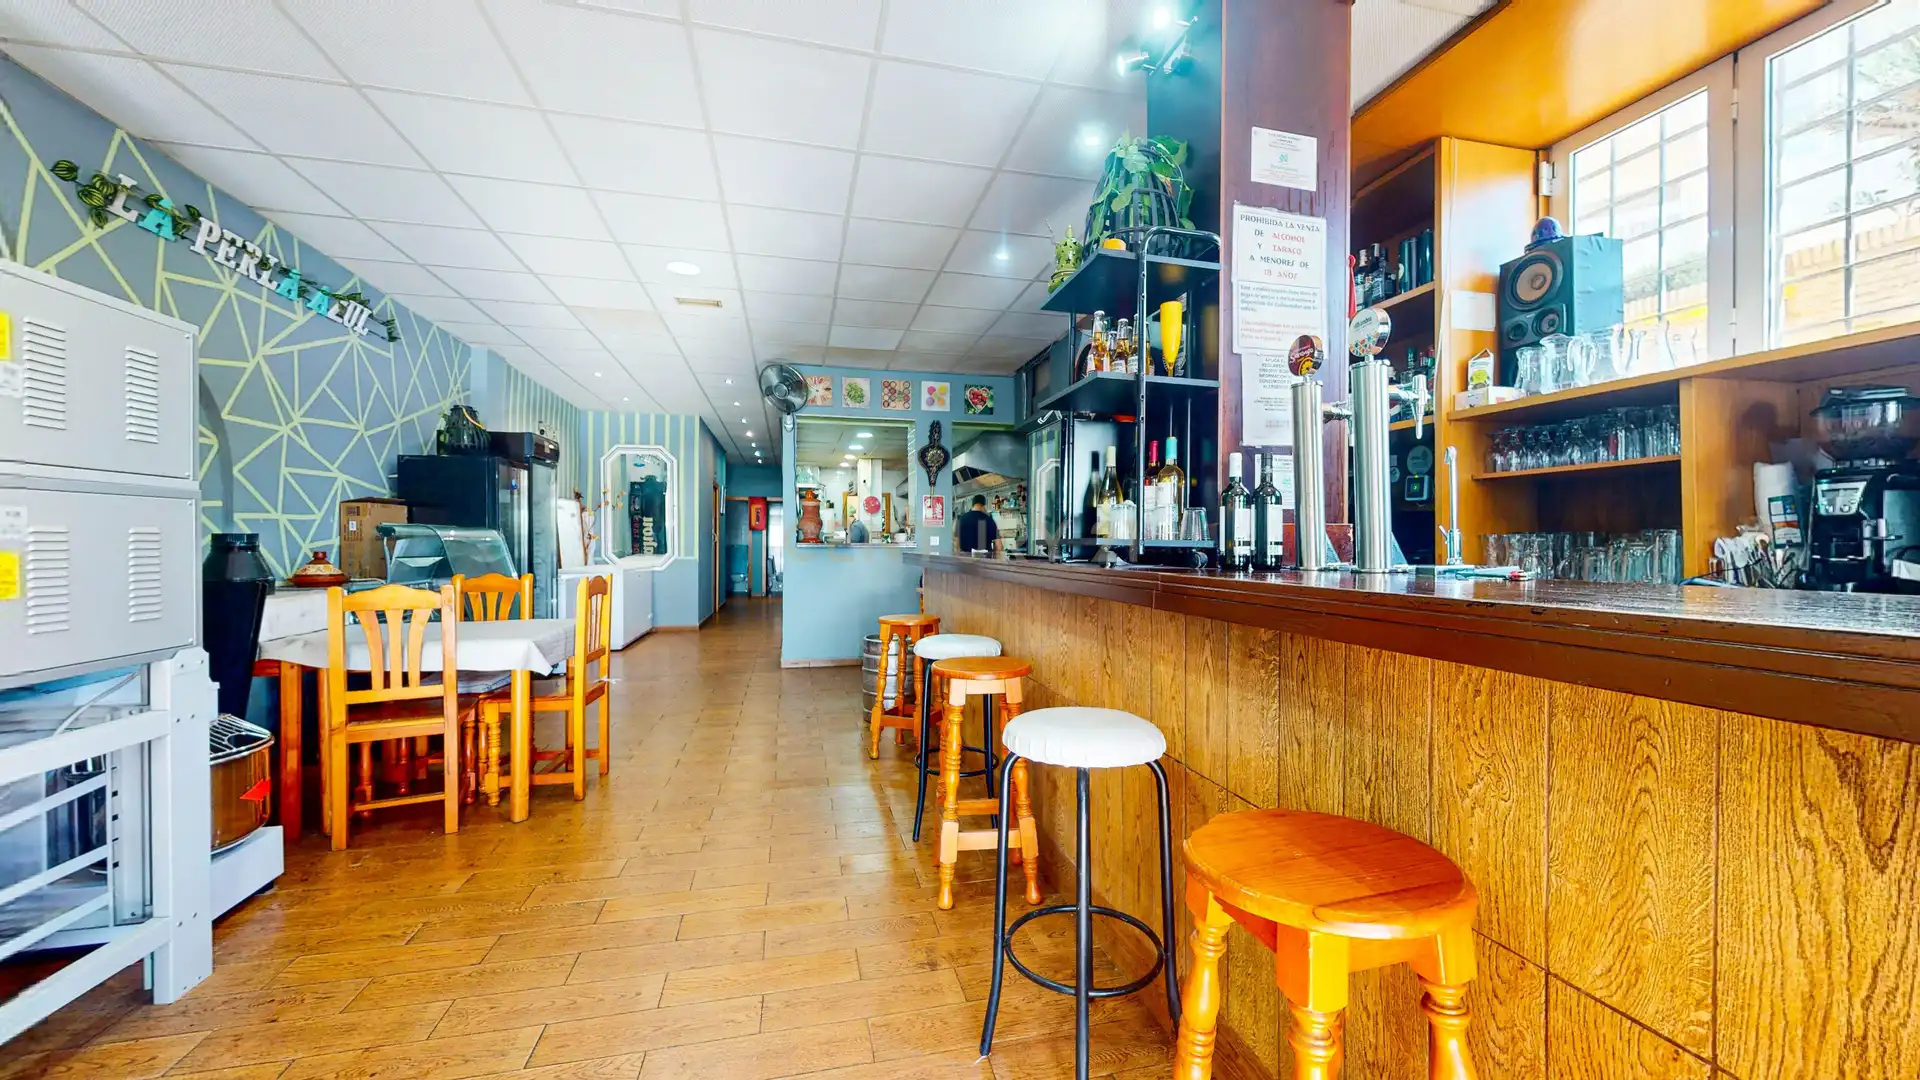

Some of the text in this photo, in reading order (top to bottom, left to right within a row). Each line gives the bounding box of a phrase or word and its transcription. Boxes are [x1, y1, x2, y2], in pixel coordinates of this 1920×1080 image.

[1240, 214, 1320, 232] PROHIBIDA LA VENTA
[107, 173, 177, 242] LA
[190, 216, 300, 303] PERLA
[1254, 228, 1305, 243] DE ALCOHOL
[1257, 242, 1302, 256] Y TABACO
[1260, 255, 1295, 267] MENORES
[1299, 261, 1309, 269] DE
